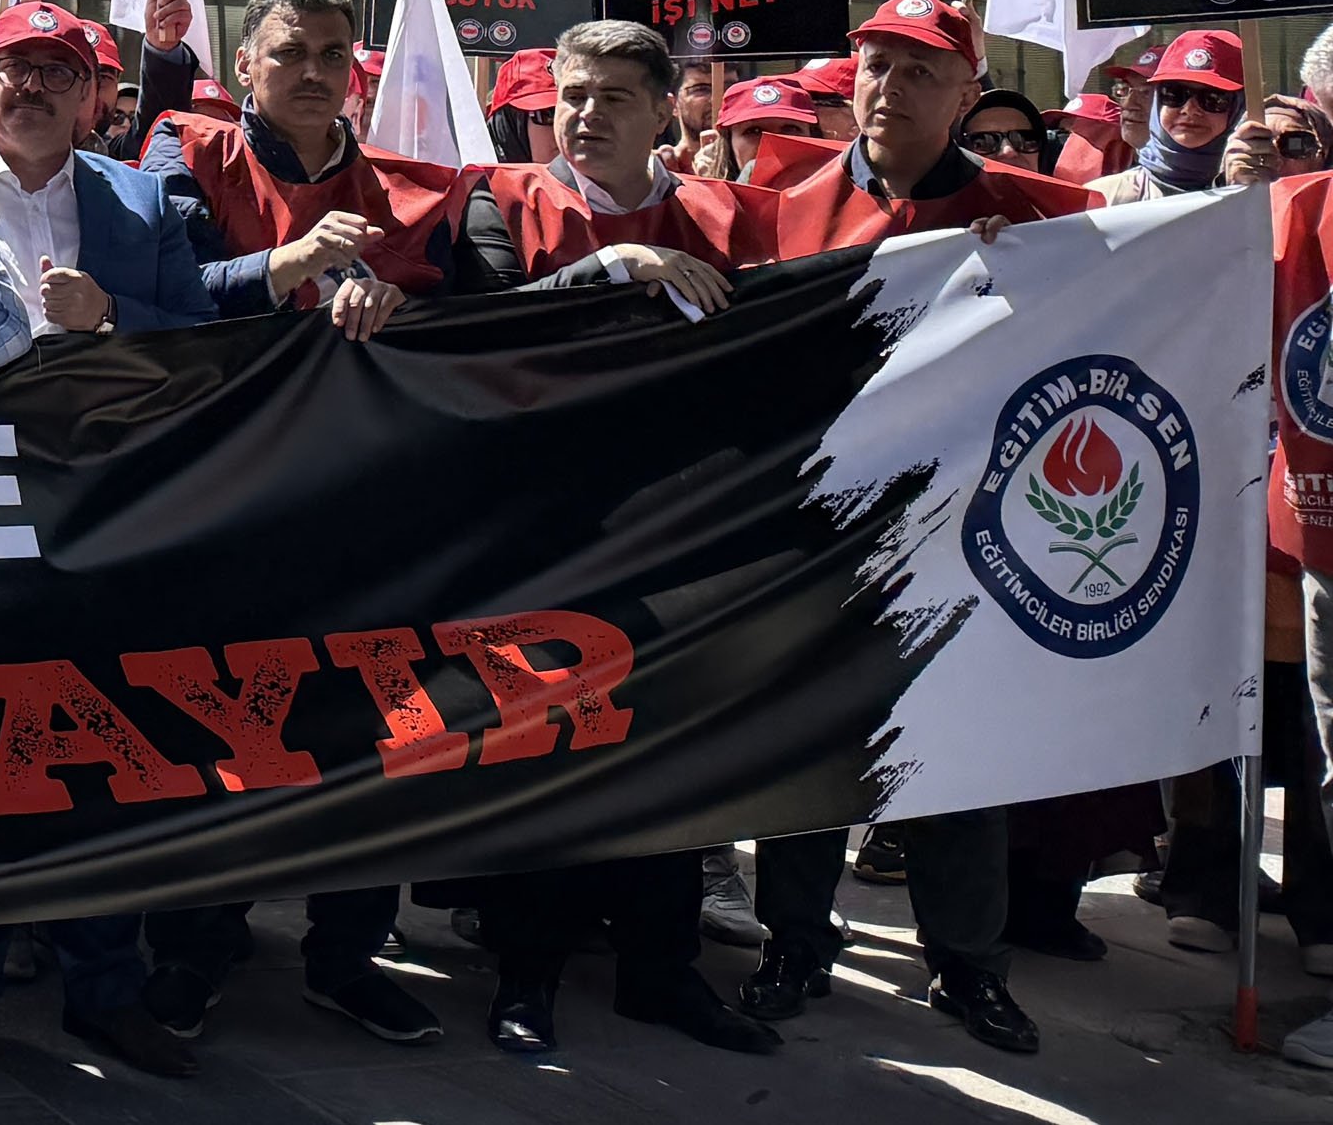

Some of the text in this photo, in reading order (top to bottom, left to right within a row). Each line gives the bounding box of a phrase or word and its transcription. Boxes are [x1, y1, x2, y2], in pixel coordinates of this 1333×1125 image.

[983, 368, 1192, 494] EĞİTİM-BİR-SEN
[976, 507, 1189, 642] EĞİTİMCİLER BİRLİĞİ SENDİKASI
[1084, 581, 1111, 599] 1992
